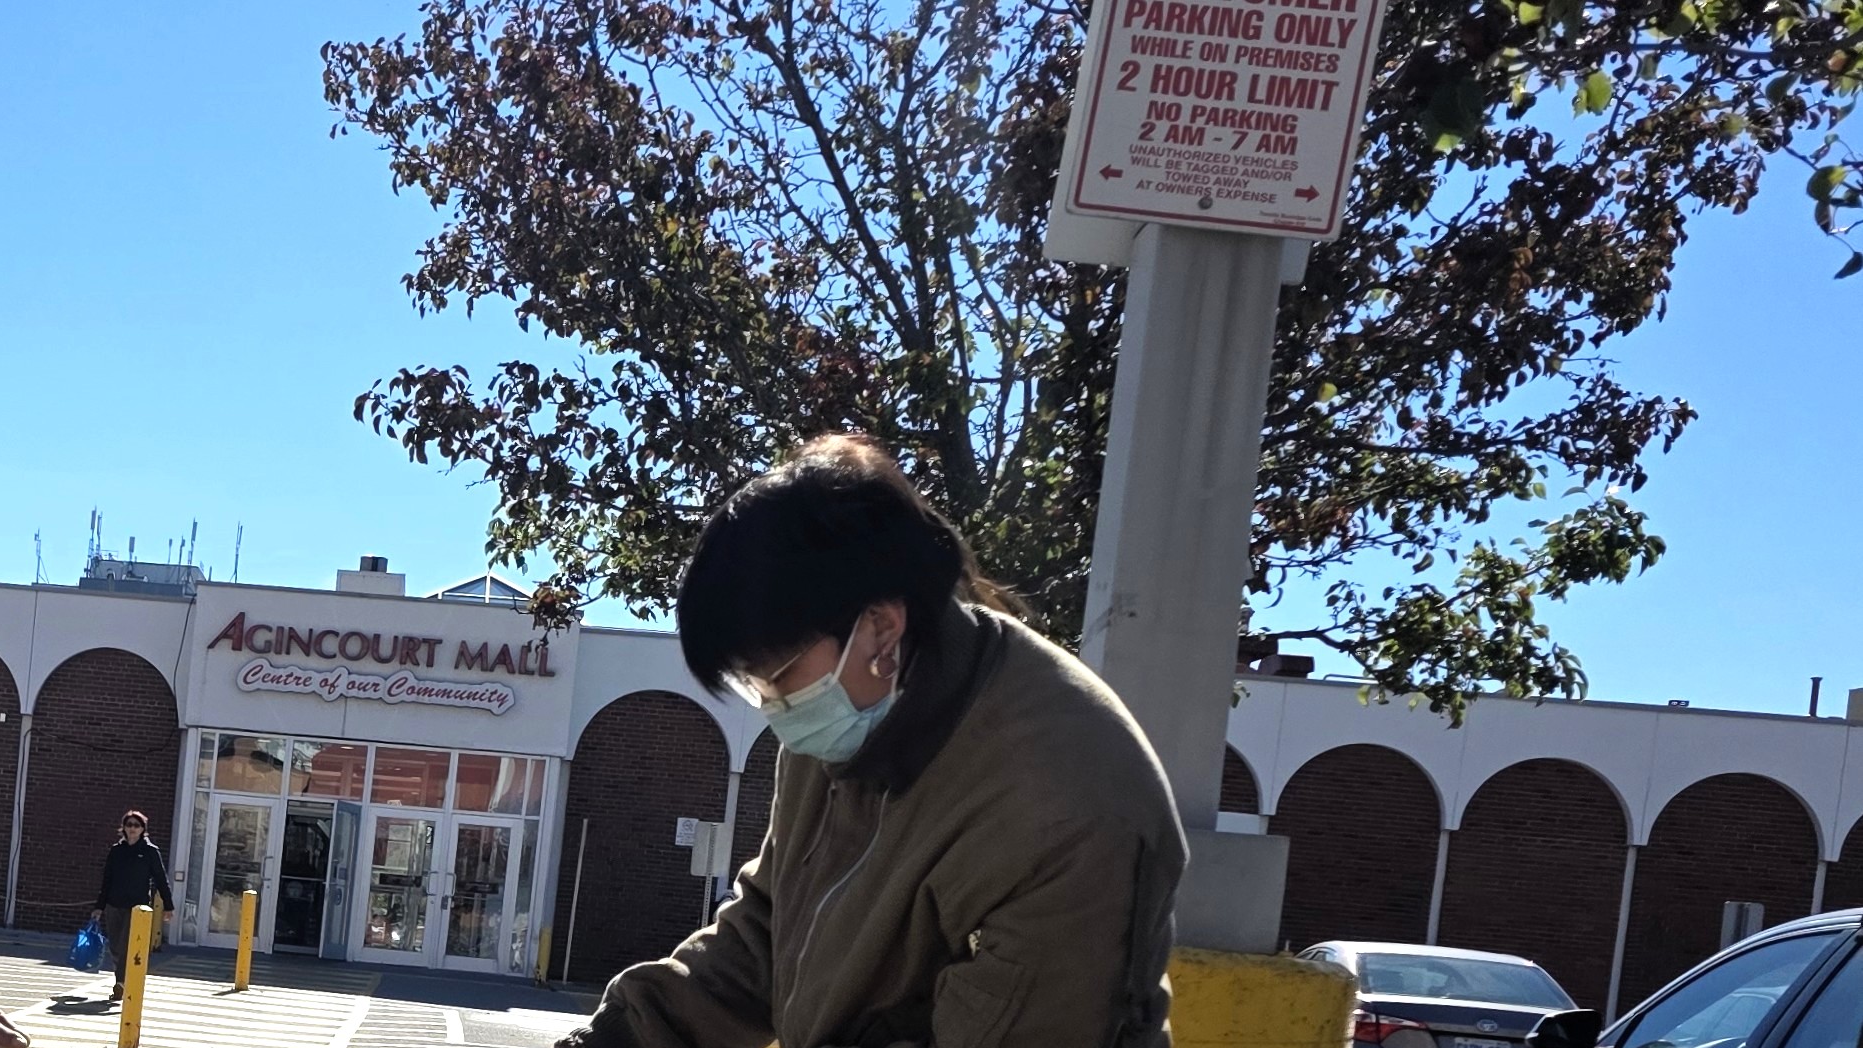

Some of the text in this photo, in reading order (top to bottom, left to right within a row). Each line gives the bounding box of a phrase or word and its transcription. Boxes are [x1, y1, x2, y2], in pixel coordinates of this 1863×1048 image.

[1123, 1, 1357, 49] PARKING ONLY
[1130, 35, 1340, 74] WHILE ON PREMISES
[1117, 60, 1339, 112] 2 HOUR LIMIT
[1147, 101, 1298, 134] NO PARKING
[1138, 122, 1156, 142] 2
[1164, 125, 1206, 147] AM
[1230, 131, 1250, 151] 7
[1255, 134, 1298, 156] AM
[1129, 144, 1299, 172] UNAUTHORIZED VEHICLES
[1130, 156, 1292, 182] WILL BE TAGGED AND/OR
[1136, 180, 1277, 204] AT OWNERS EXPENSE
[1165, 170, 1250, 189] TOWED AWAY
[207, 612, 556, 678] AGINCOURT MALL
[242, 664, 510, 708] Centre of our Community
